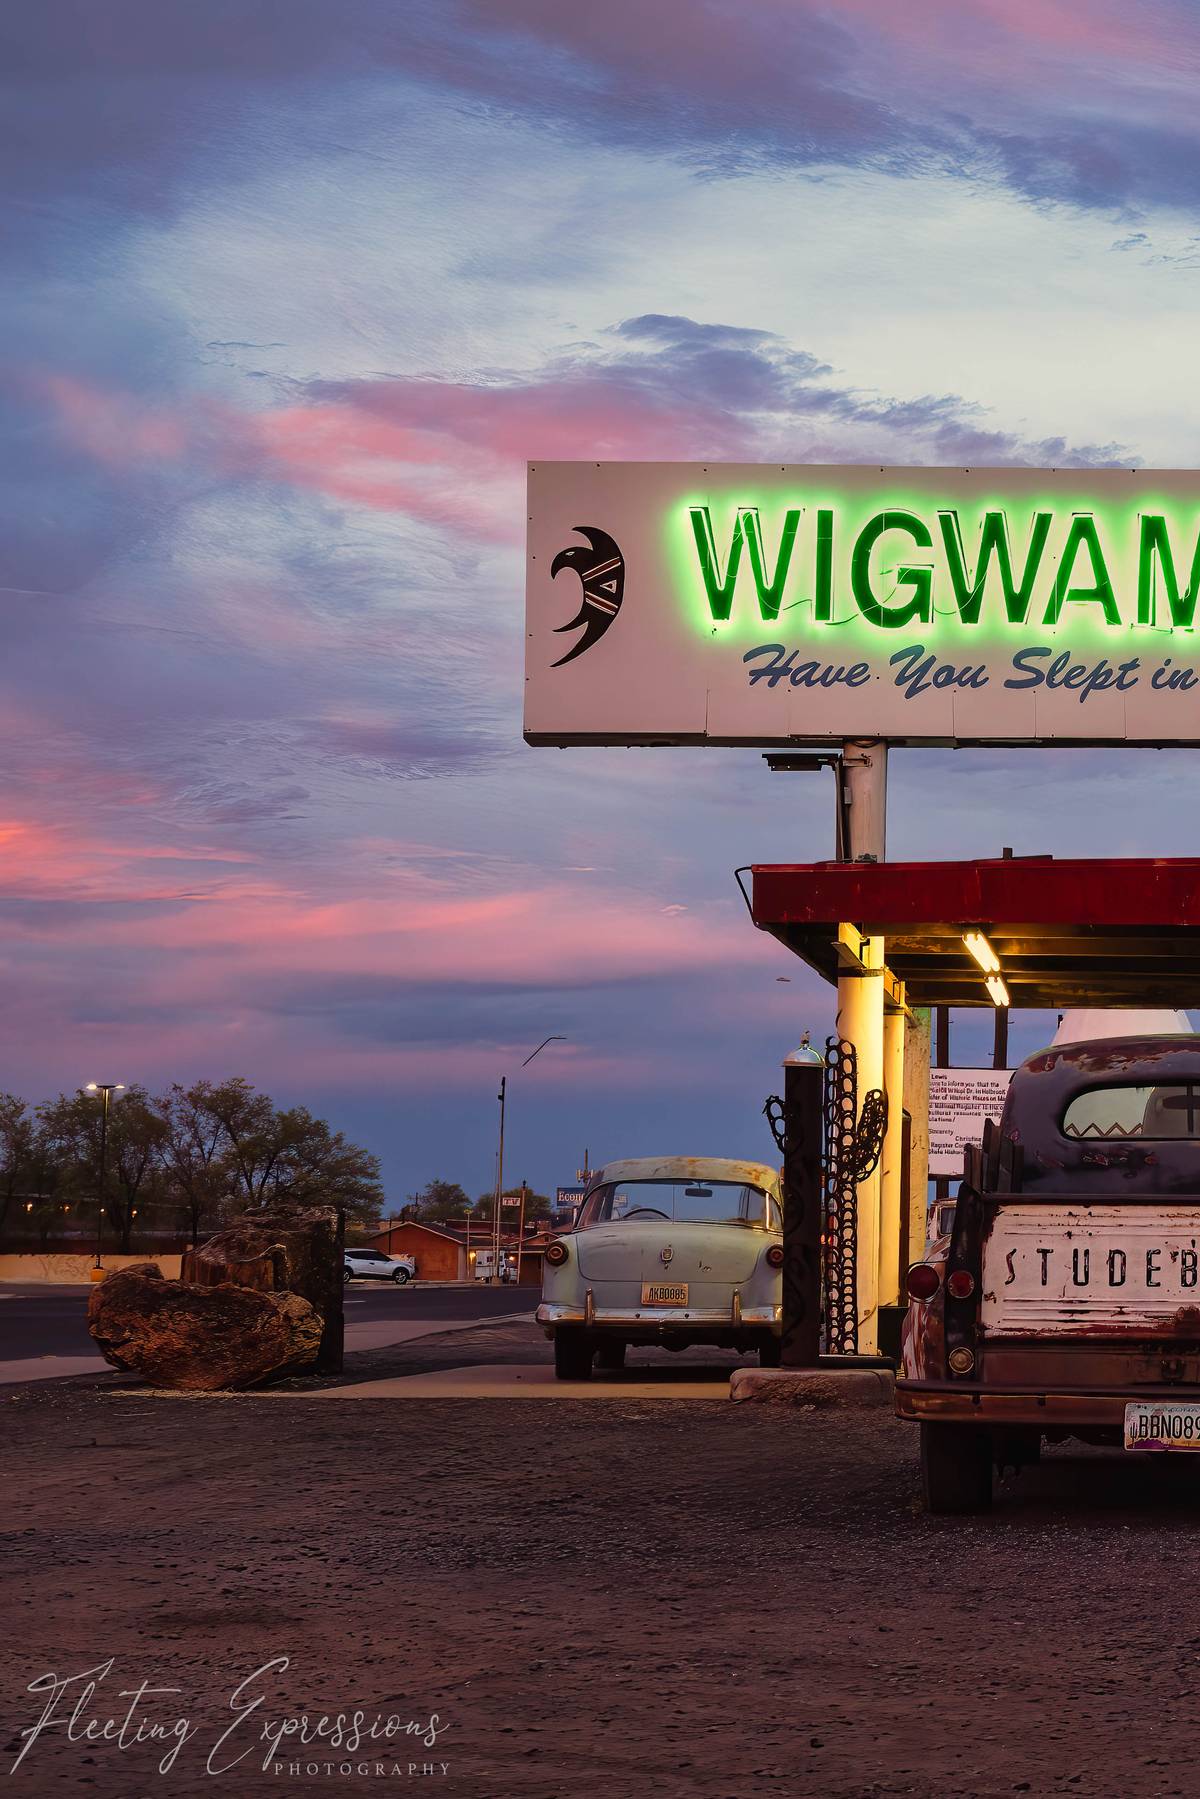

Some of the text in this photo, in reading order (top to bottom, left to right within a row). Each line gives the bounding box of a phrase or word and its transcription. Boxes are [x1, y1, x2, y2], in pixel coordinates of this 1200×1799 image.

[742, 644, 872, 689] Have
[889, 646, 990, 700] You
[1004, 646, 1140, 704] Slept
[1150, 657, 1198, 691] in
